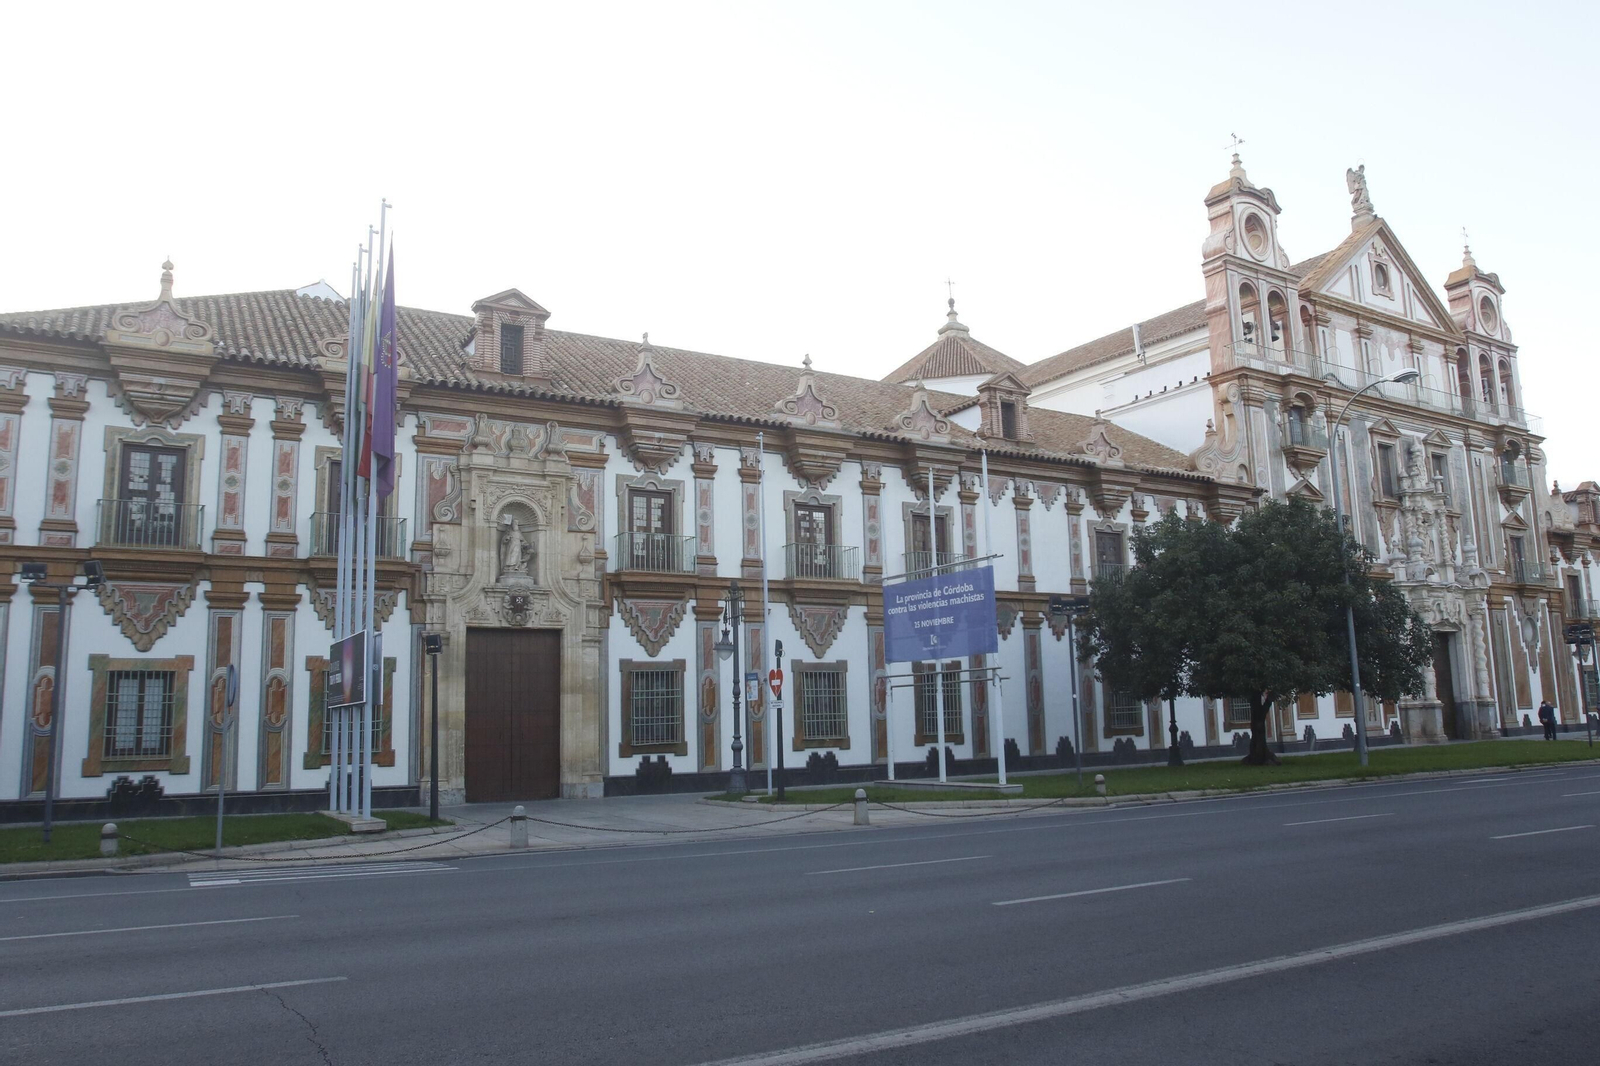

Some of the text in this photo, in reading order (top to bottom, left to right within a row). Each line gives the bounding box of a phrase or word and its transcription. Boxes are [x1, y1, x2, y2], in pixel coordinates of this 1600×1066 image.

[888, 593, 984, 615] contra las violencias machistas
[896, 583, 974, 604] La provincia de Córdoba
[921, 616, 954, 628] NOVIEMBRE
